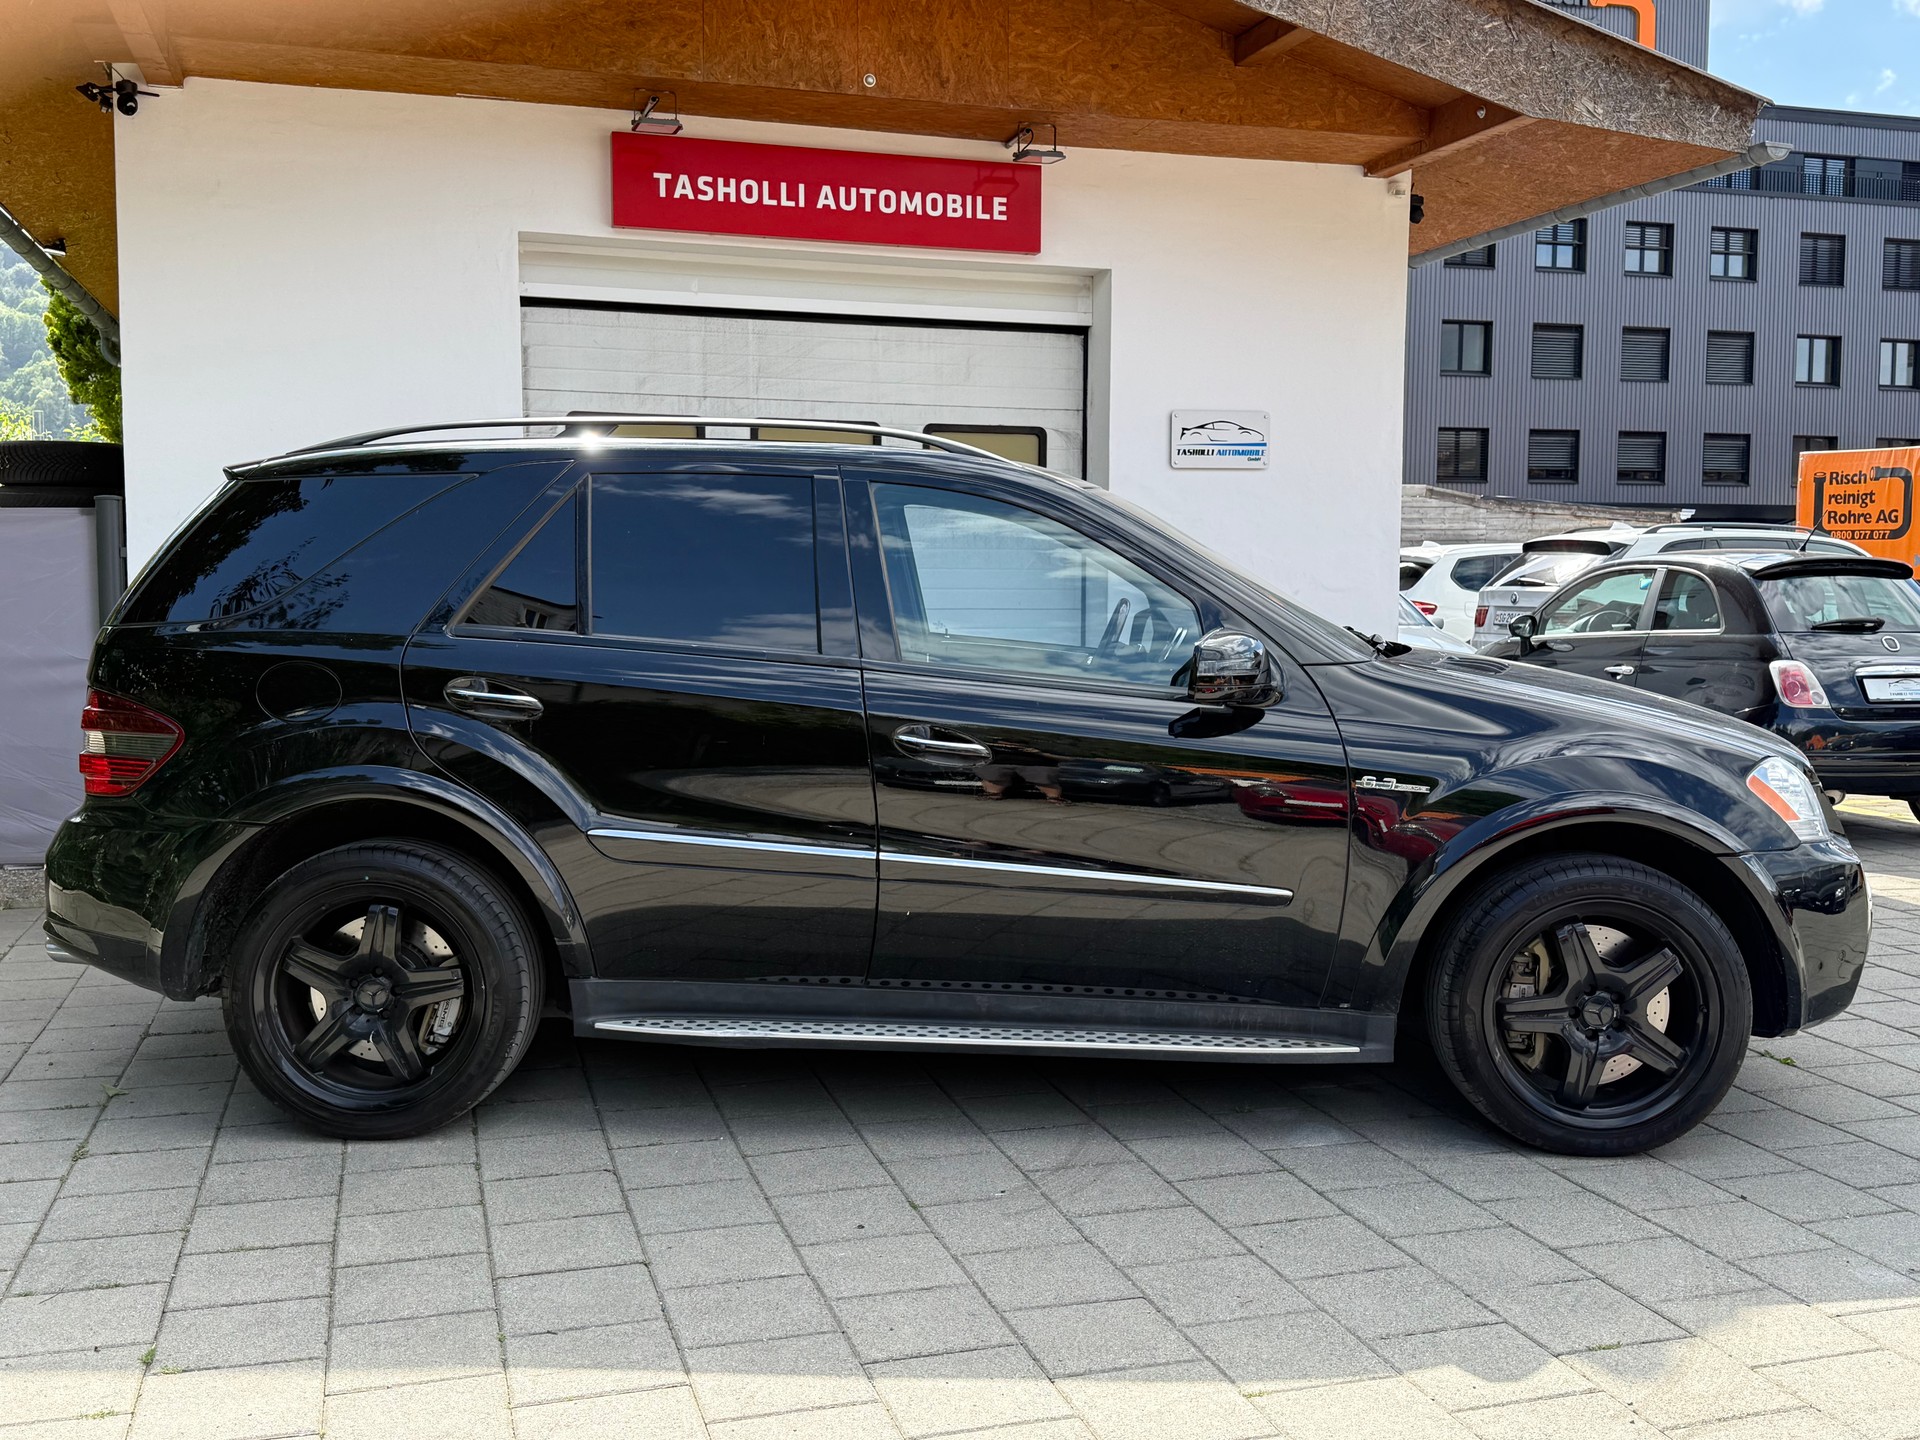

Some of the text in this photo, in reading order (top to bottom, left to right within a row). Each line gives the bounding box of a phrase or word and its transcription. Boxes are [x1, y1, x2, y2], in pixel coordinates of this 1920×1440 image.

[653, 172, 1008, 221] TASHOLLI AUTOMOBILE
[1177, 448, 1266, 457] TASHOLLI AUTOMOBILE
[1829, 470, 1867, 486] Risch
[1828, 490, 1876, 508] reinigt
[1827, 509, 1899, 524] Rohre AG
[1831, 530, 1890, 540] 0800 077 077
